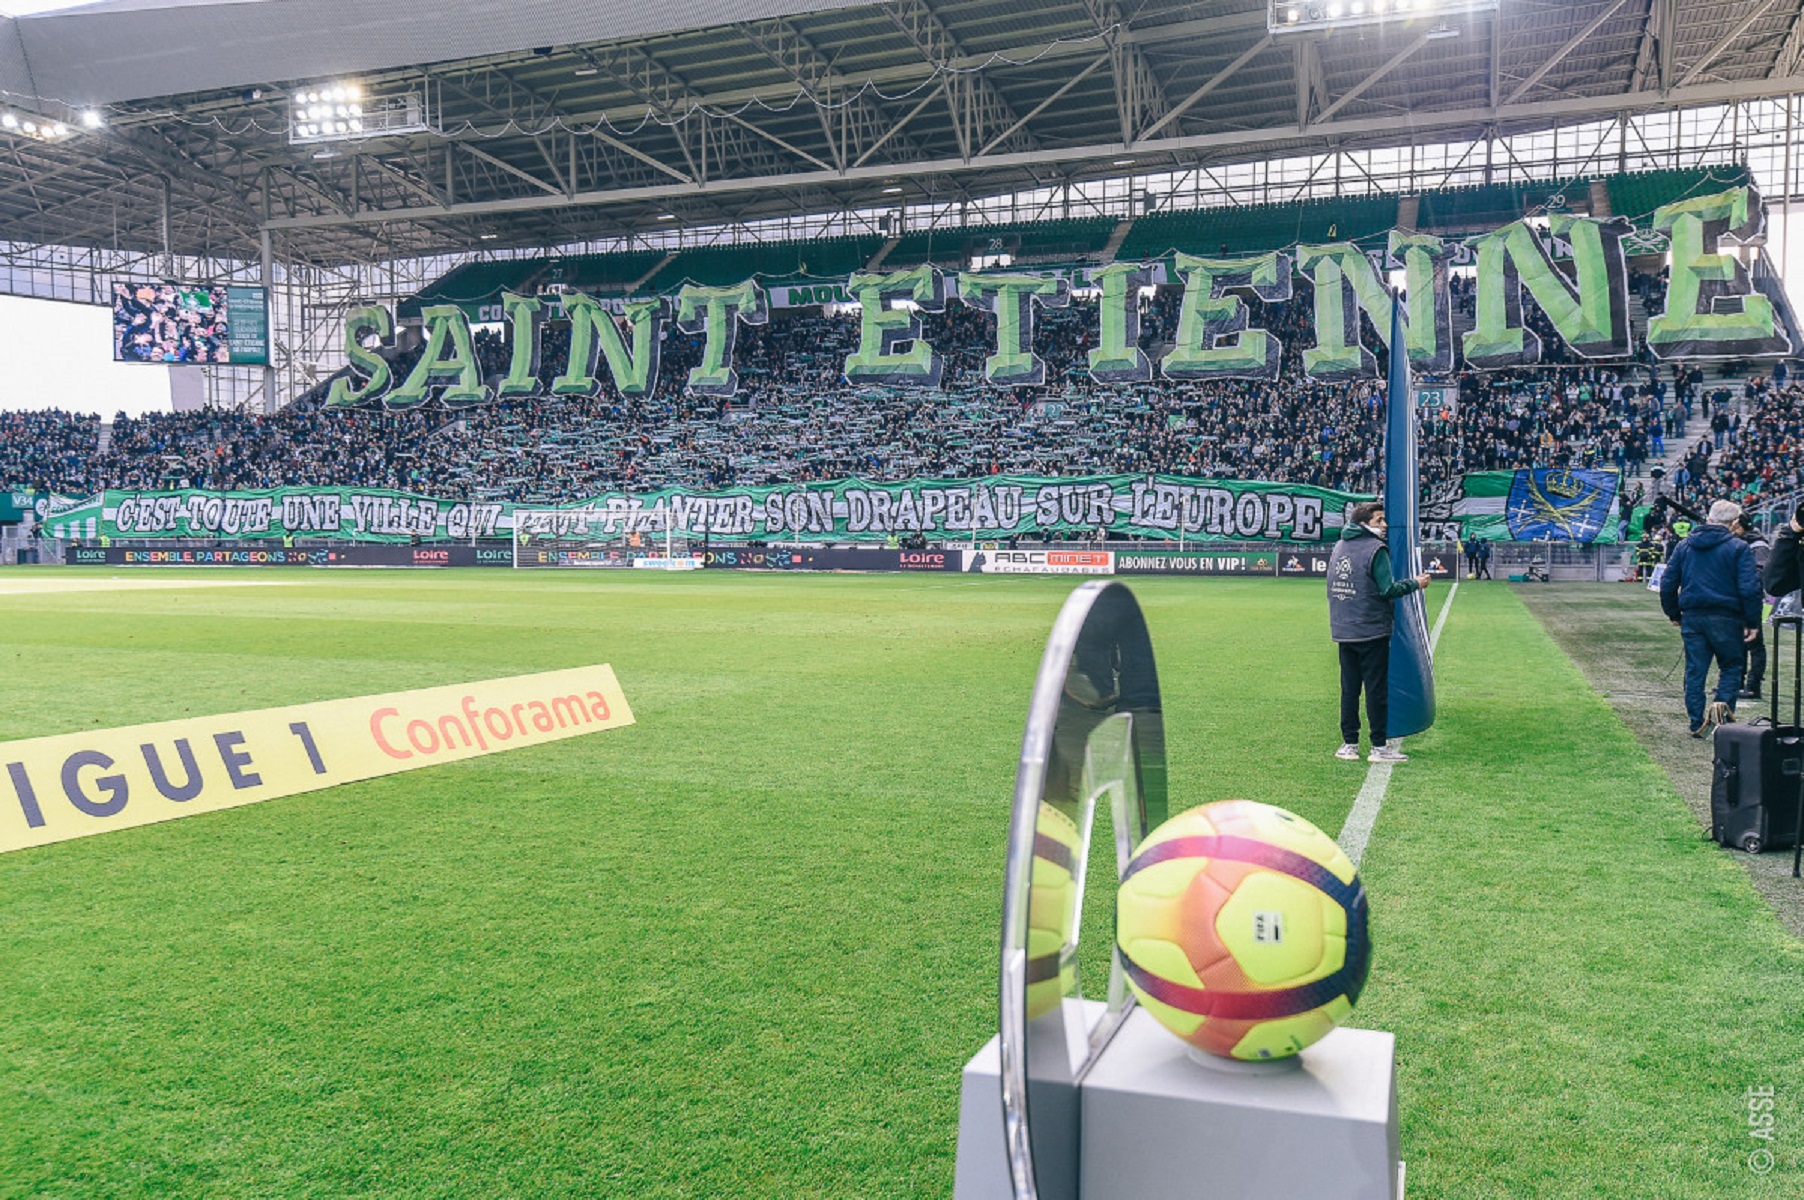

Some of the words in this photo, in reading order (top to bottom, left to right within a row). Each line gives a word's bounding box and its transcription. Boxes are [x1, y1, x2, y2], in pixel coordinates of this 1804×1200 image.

[1548, 194, 1566, 208] 29
[988, 237, 1003, 251] 28
[321, 279, 767, 410] SAINT
[845, 185, 1792, 386] ETIENNE
[1420, 391, 1441, 407] 23
[13, 495, 34, 506] V34
[116, 492, 182, 533] C'EST
[187, 494, 273, 534] TOUTE
[281, 493, 341, 532] UNE
[351, 493, 439, 538] VILLE
[446, 502, 503, 538] QUI
[603, 493, 754, 534] PLANTER
[765, 489, 835, 533] SON
[844, 485, 1025, 533] DRAPEAU
[1036, 482, 1116, 526] SUR
[1129, 475, 1324, 541] L'EUROPE
[196, 551, 286, 563] PARTAGEONS
[994, 552, 1046, 564] ABC
[1118, 556, 1167, 569] ABONNEZ
[1169, 556, 1198, 570] VOUS
[1200, 557, 1214, 570] EN
[289, 721, 327, 775] 1
[370, 690, 612, 760] Conforama
